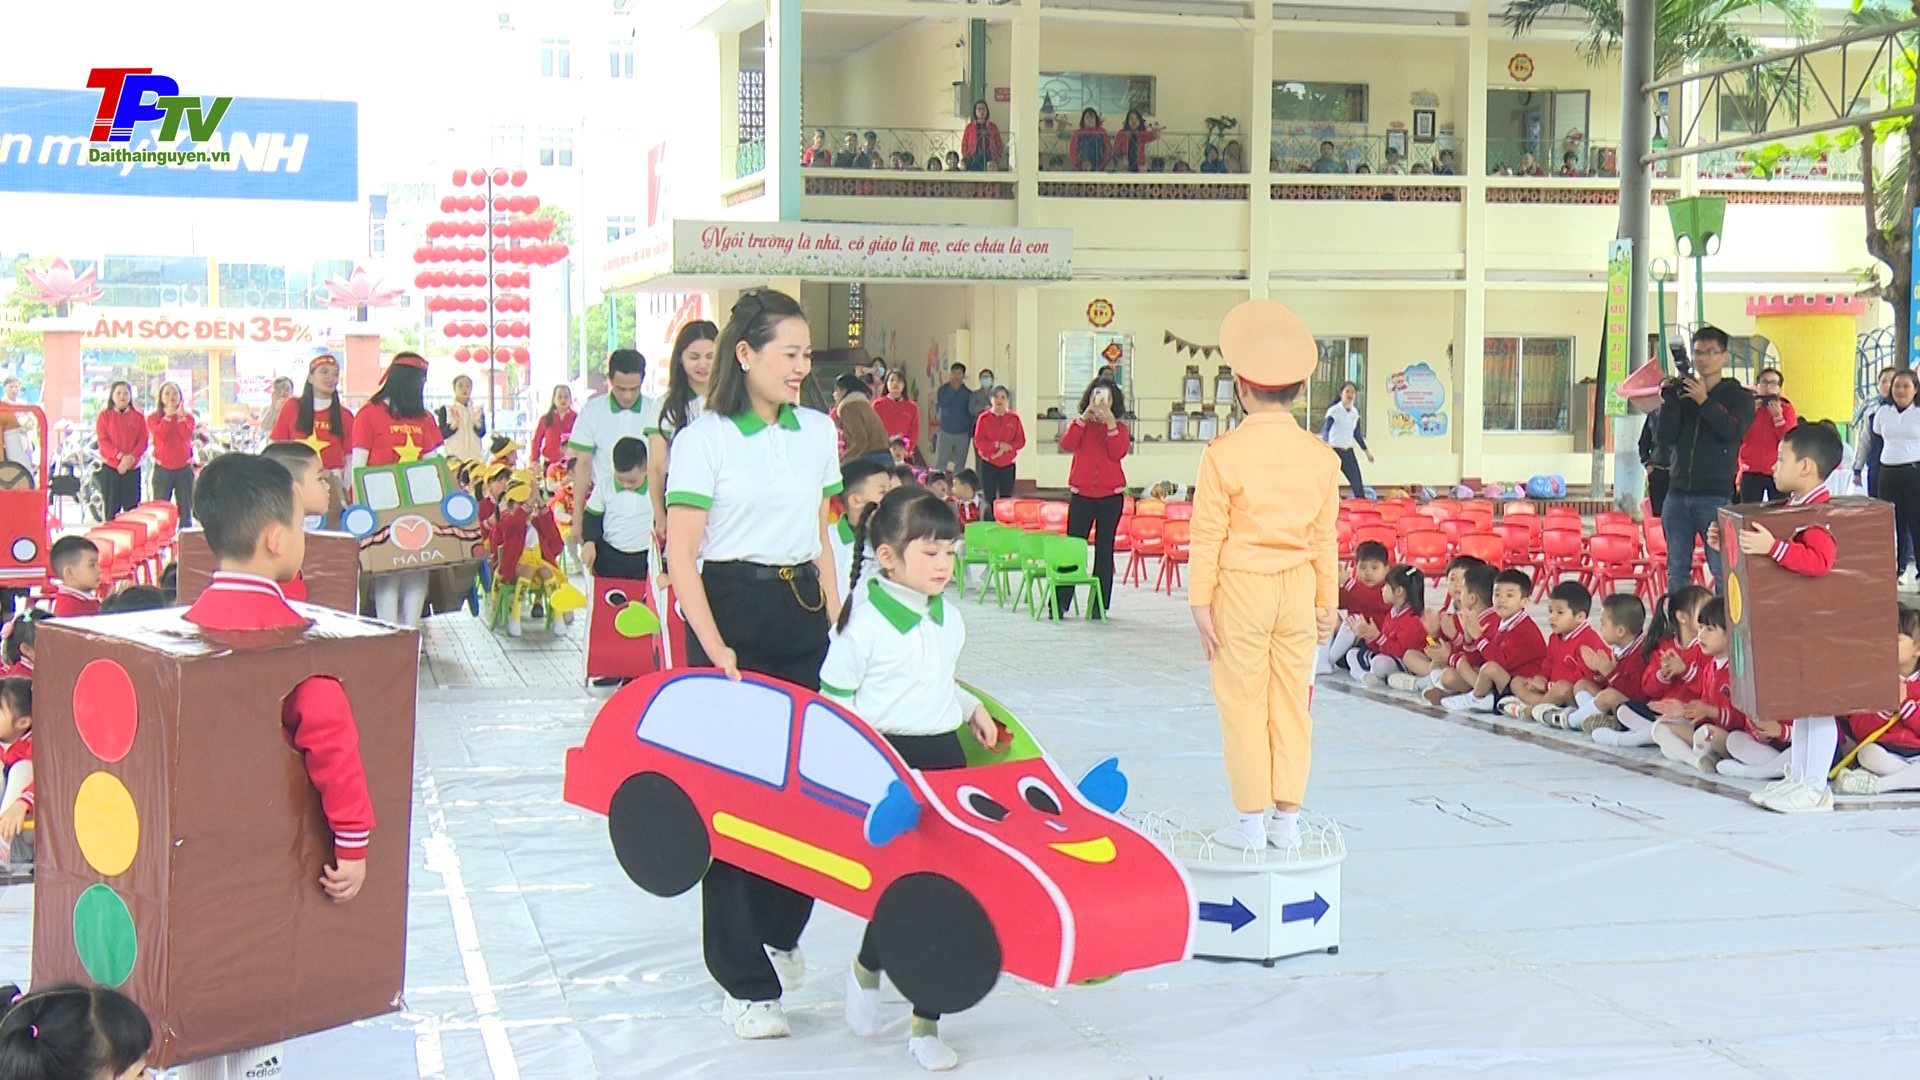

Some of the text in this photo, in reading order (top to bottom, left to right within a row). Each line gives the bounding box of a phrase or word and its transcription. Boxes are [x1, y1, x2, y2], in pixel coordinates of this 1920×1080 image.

[701, 225, 746, 251] Ngôi
[748, 231, 794, 255] trường
[797, 231, 812, 250] là
[848, 235, 865, 250] cô
[867, 234, 898, 256] giáo
[901, 233, 915, 251] là
[946, 237, 971, 254] các
[973, 235, 1005, 254] cháu
[1009, 235, 1023, 254] là
[1025, 241, 1049, 254] con
[194, 314, 245, 340] ĐẾN
[250, 316, 313, 342] 35%
